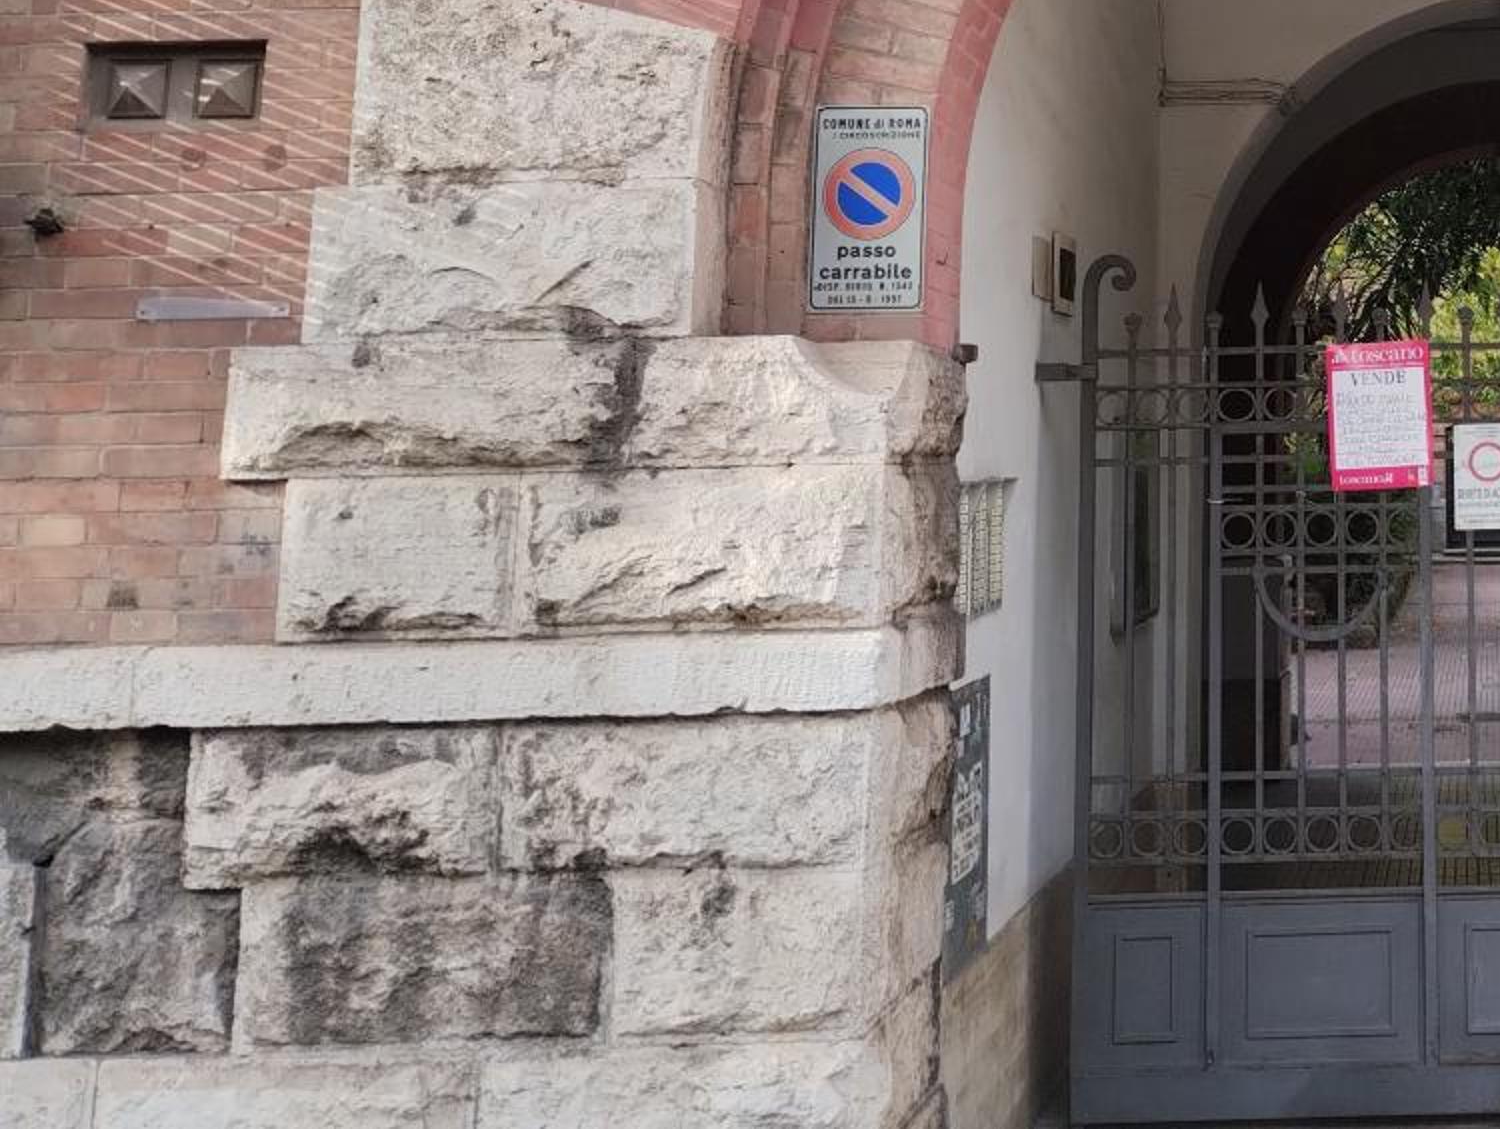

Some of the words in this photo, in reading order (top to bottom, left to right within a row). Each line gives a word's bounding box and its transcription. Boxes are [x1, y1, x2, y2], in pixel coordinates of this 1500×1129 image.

[823, 118, 870, 129] COMUNE
[889, 118, 921, 129] ROMA
[836, 245, 897, 260] passo
[819, 262, 913, 280] carrabile
[1350, 371, 1407, 386] VENDE
